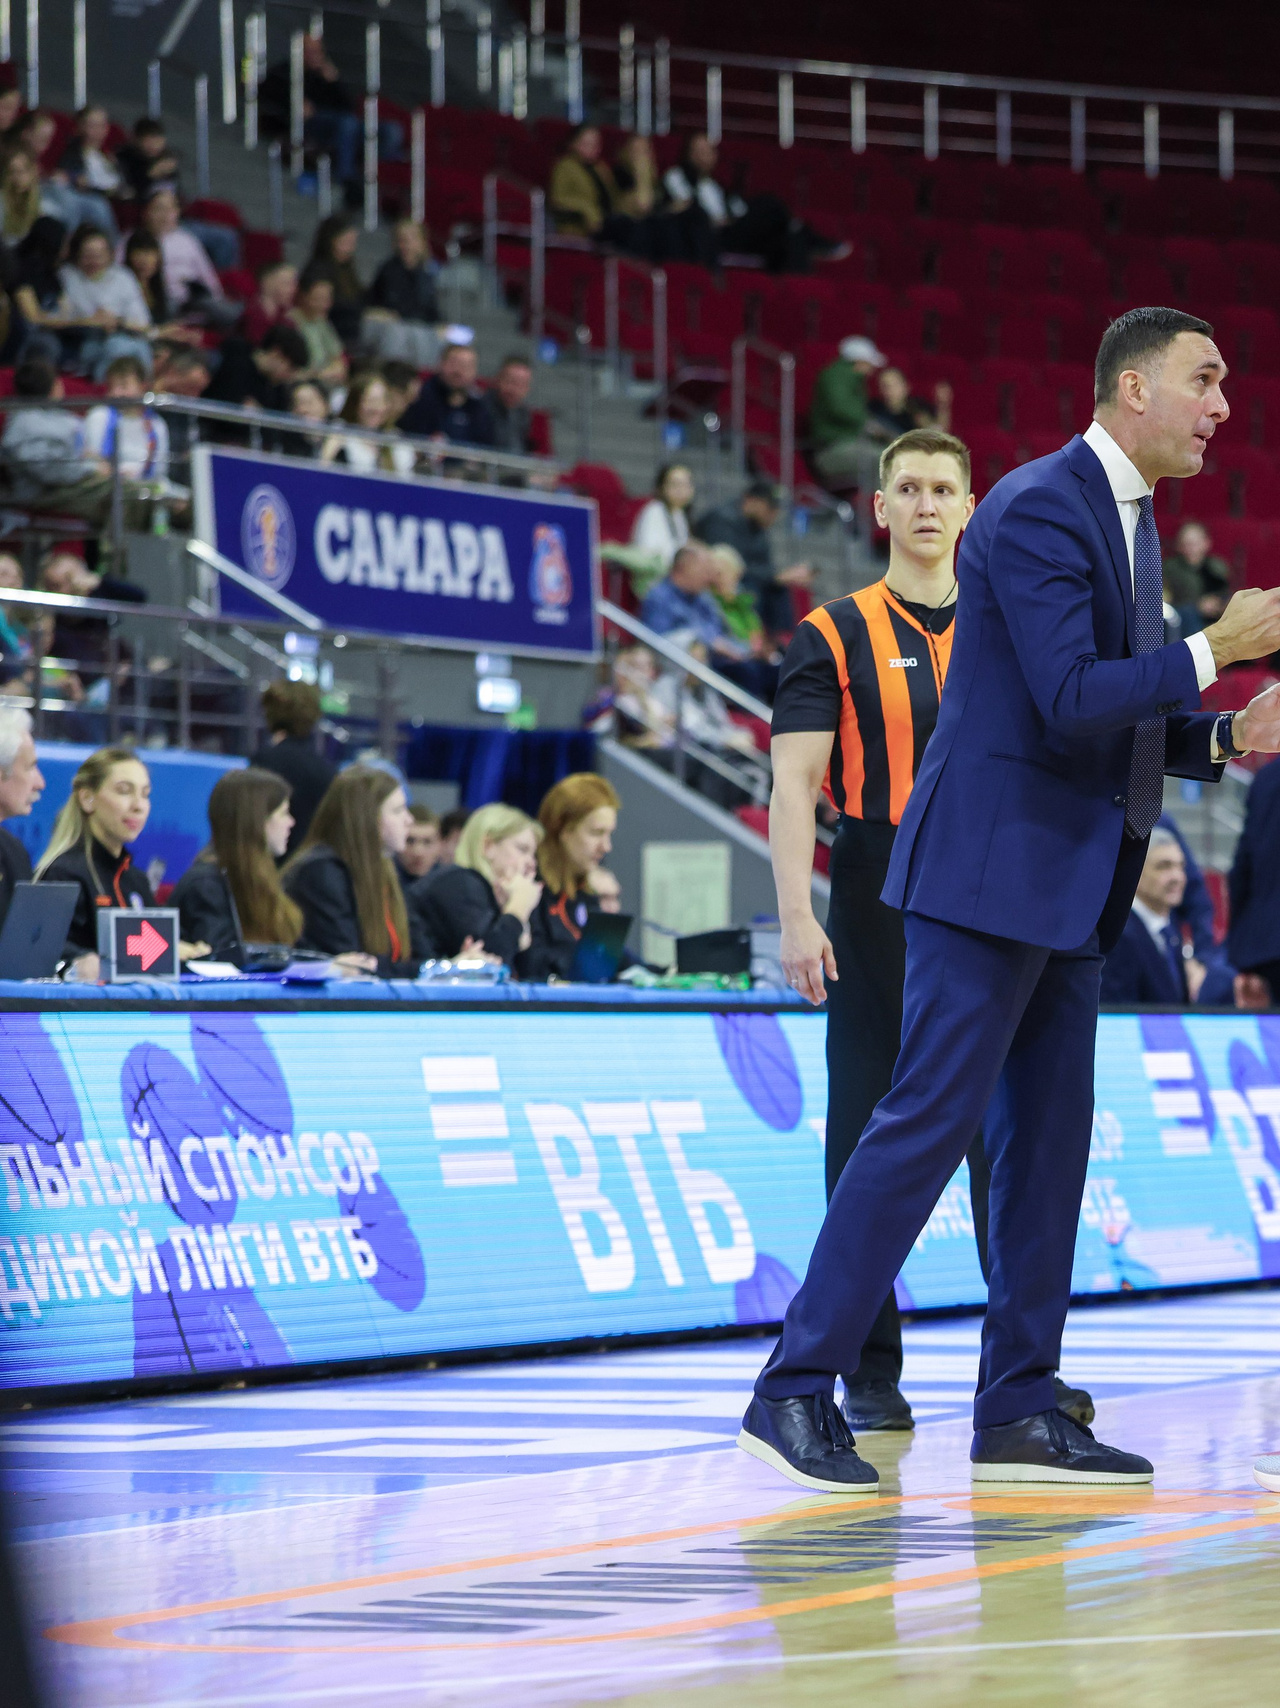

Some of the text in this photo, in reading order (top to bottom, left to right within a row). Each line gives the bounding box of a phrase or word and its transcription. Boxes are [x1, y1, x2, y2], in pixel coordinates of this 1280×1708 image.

[313, 502, 515, 603] САМАРА
[888, 657, 918, 668] ZEDO
[179, 1131, 380, 1202] СПОНСОР
[524, 1099, 757, 1293] ВТБ
[168, 1221, 296, 1292] ЛИГИ
[290, 1214, 379, 1283] ВТБ
